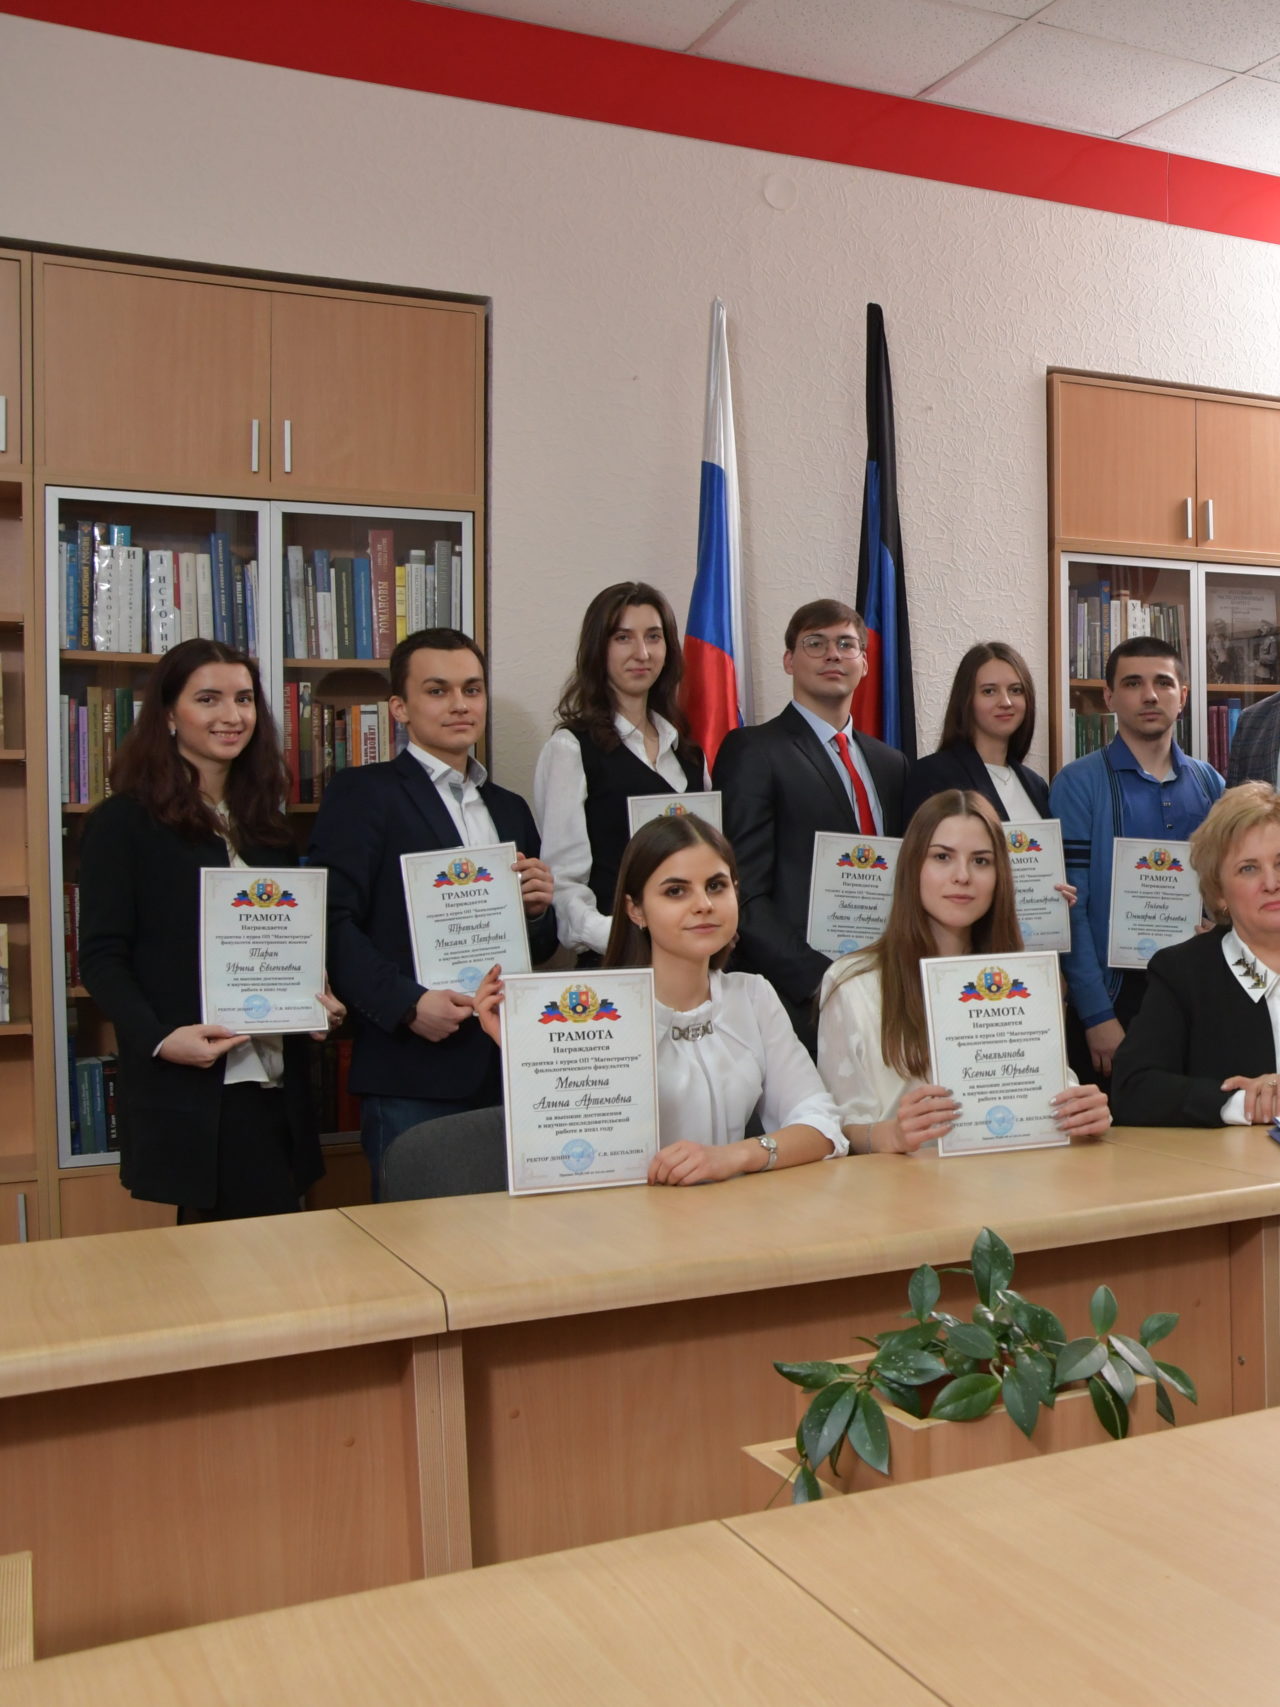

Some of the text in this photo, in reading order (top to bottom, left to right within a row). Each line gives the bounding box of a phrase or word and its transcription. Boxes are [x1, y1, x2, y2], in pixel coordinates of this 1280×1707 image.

[378, 581, 390, 634] РОМАНОВЫ
[841, 872, 882, 881] ГРАМОТА
[1140, 874, 1178, 883] ГРАМОТА
[441, 888, 489, 900] ГРАМОТА
[239, 913, 291, 922] ГРАМОТА
[249, 948, 279, 959] Таран
[226, 962, 301, 974] Ирина Евгеньевна
[969, 1006, 1025, 1019] ГРАМОТА
[973, 1020, 1022, 1029] Награждается
[549, 1029, 614, 1043] ГРАМОТА
[553, 1044, 610, 1055] Награждается
[975, 1049, 1025, 1063] Емельянова
[962, 1064, 1040, 1080] Ксения Юрьевна
[555, 1074, 610, 1090] Менякина
[532, 1093, 632, 1110] Алина Артемовна
